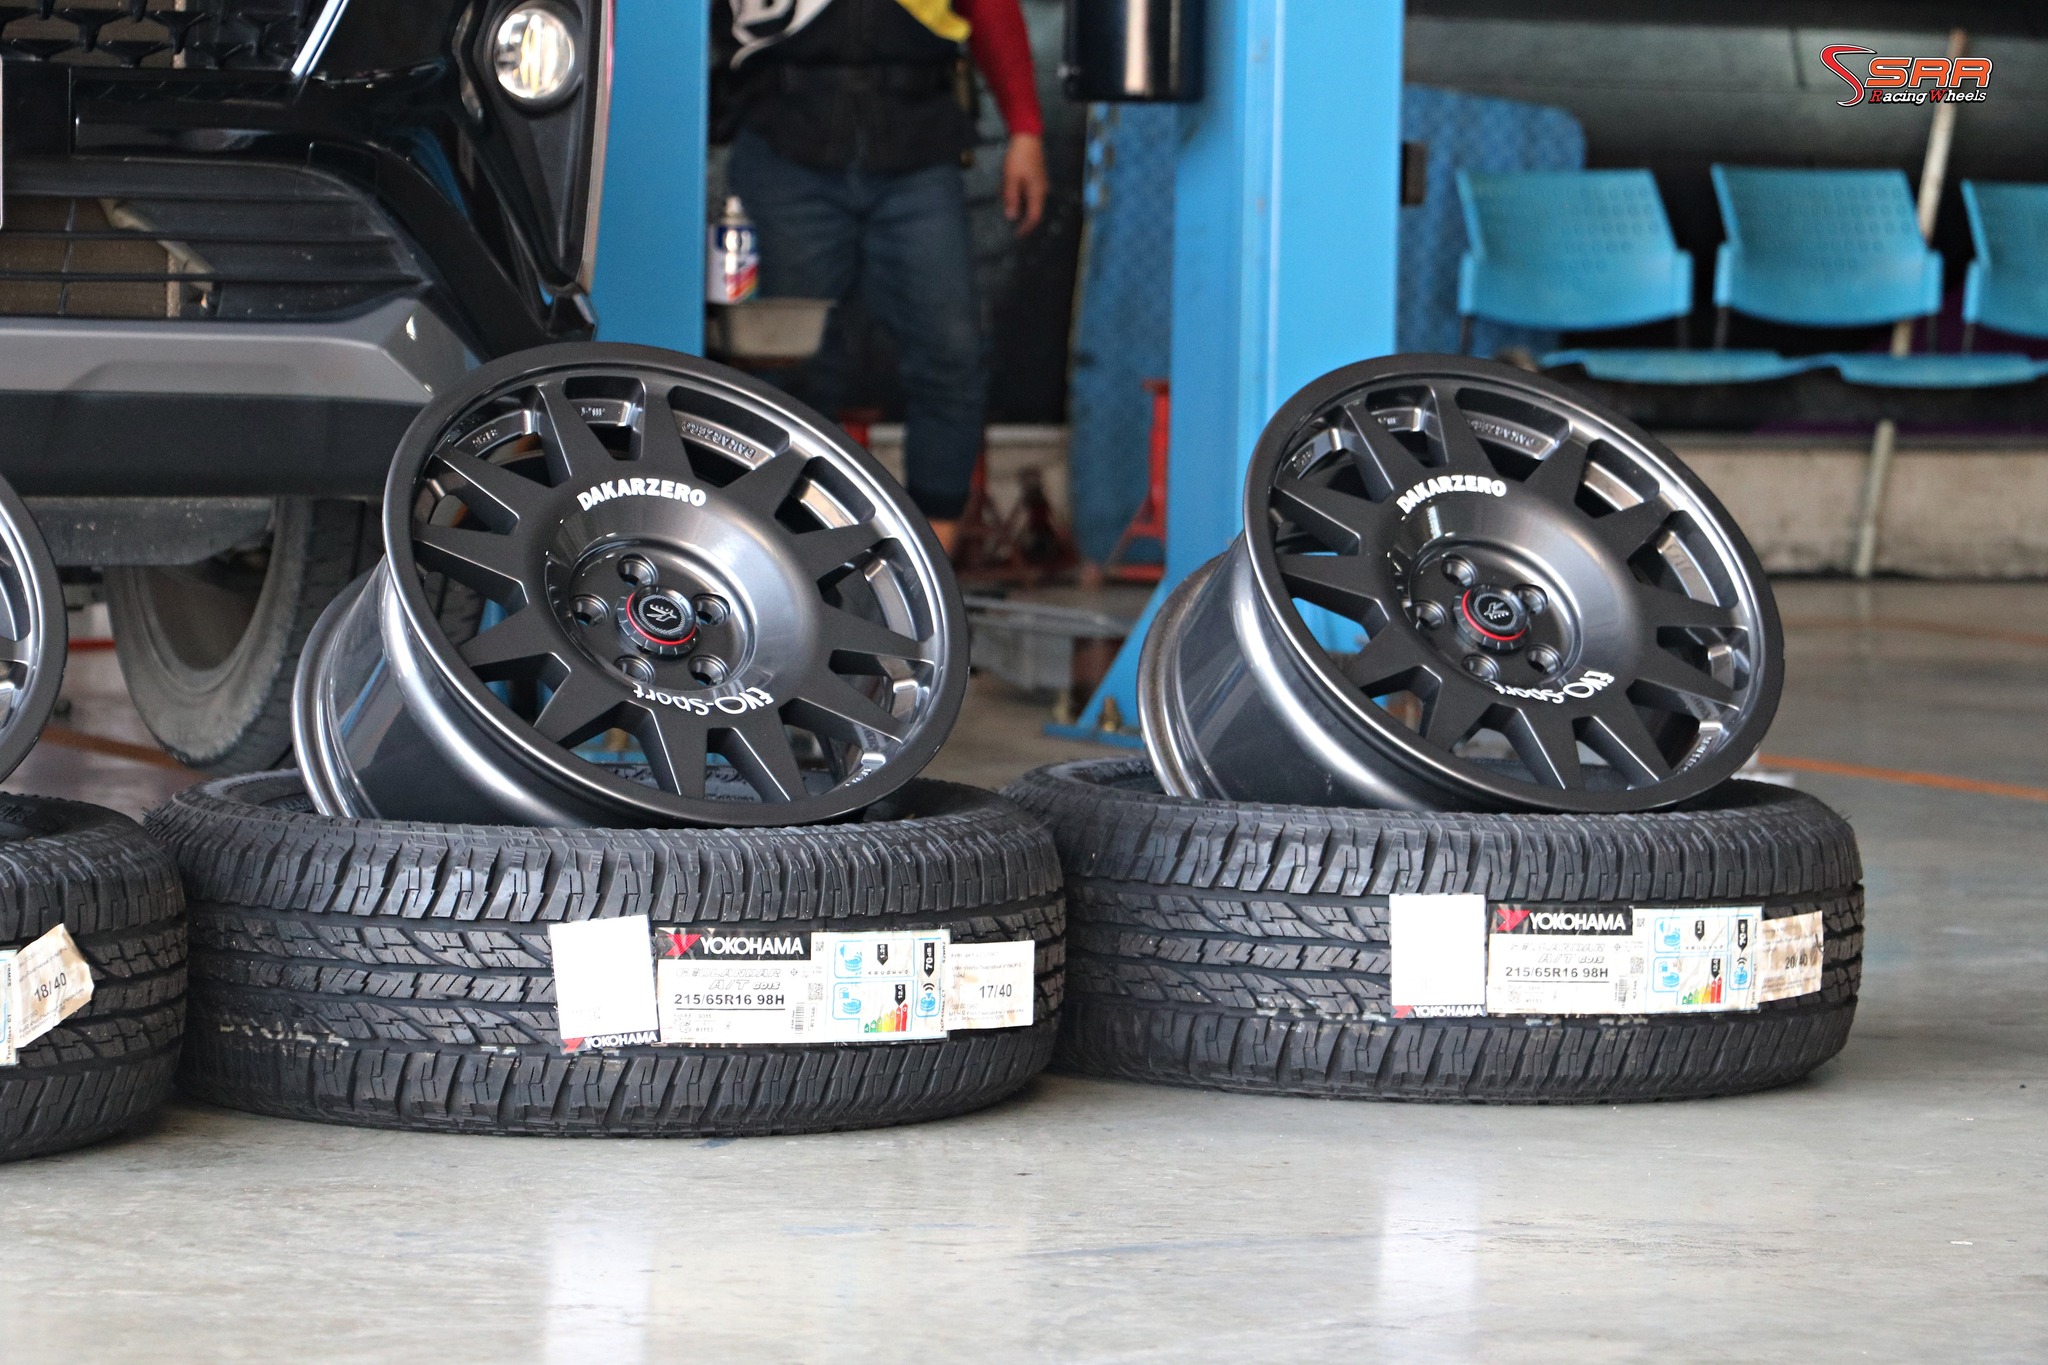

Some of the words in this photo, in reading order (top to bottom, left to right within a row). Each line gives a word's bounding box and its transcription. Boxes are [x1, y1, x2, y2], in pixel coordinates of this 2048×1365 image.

[577, 477, 707, 511] DAKARZERO
[1396, 474, 1507, 514] DAKARZERO
[633, 681, 774, 716] EVO-Sport
[1529, 912, 1626, 931] YOKOHAMA
[701, 936, 804, 956] YOKOHAMA
[1505, 966, 1579, 978] 215/65R16
[1583, 968, 1609, 978] 98H
[709, 979, 750, 990] A/T
[980, 984, 1012, 998] 17/40
[674, 994, 752, 1006] 215/65R16
[757, 994, 785, 1005] 98H
[1412, 1005, 1484, 1018] YOKOHAMA
[583, 1031, 658, 1048] YOKOHAMA
